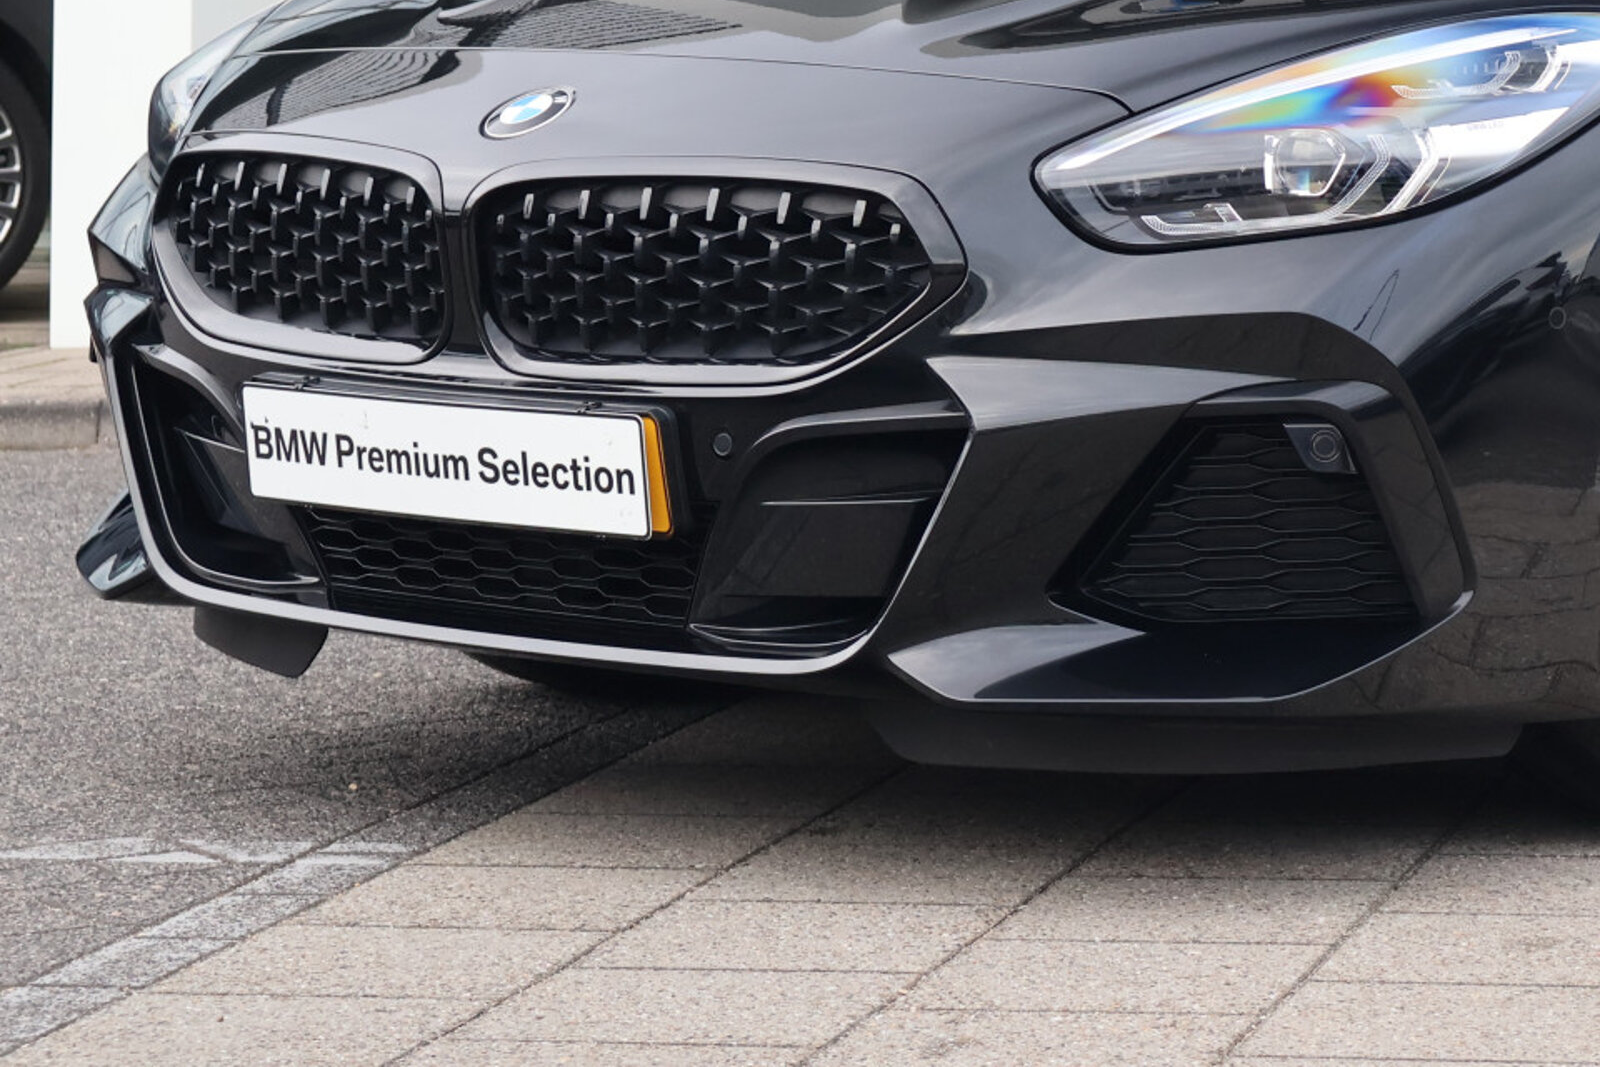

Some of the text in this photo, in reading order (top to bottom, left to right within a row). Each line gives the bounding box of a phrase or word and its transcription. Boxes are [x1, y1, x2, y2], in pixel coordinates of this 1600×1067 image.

[252, 424, 636, 496] BMW Premium Selection
